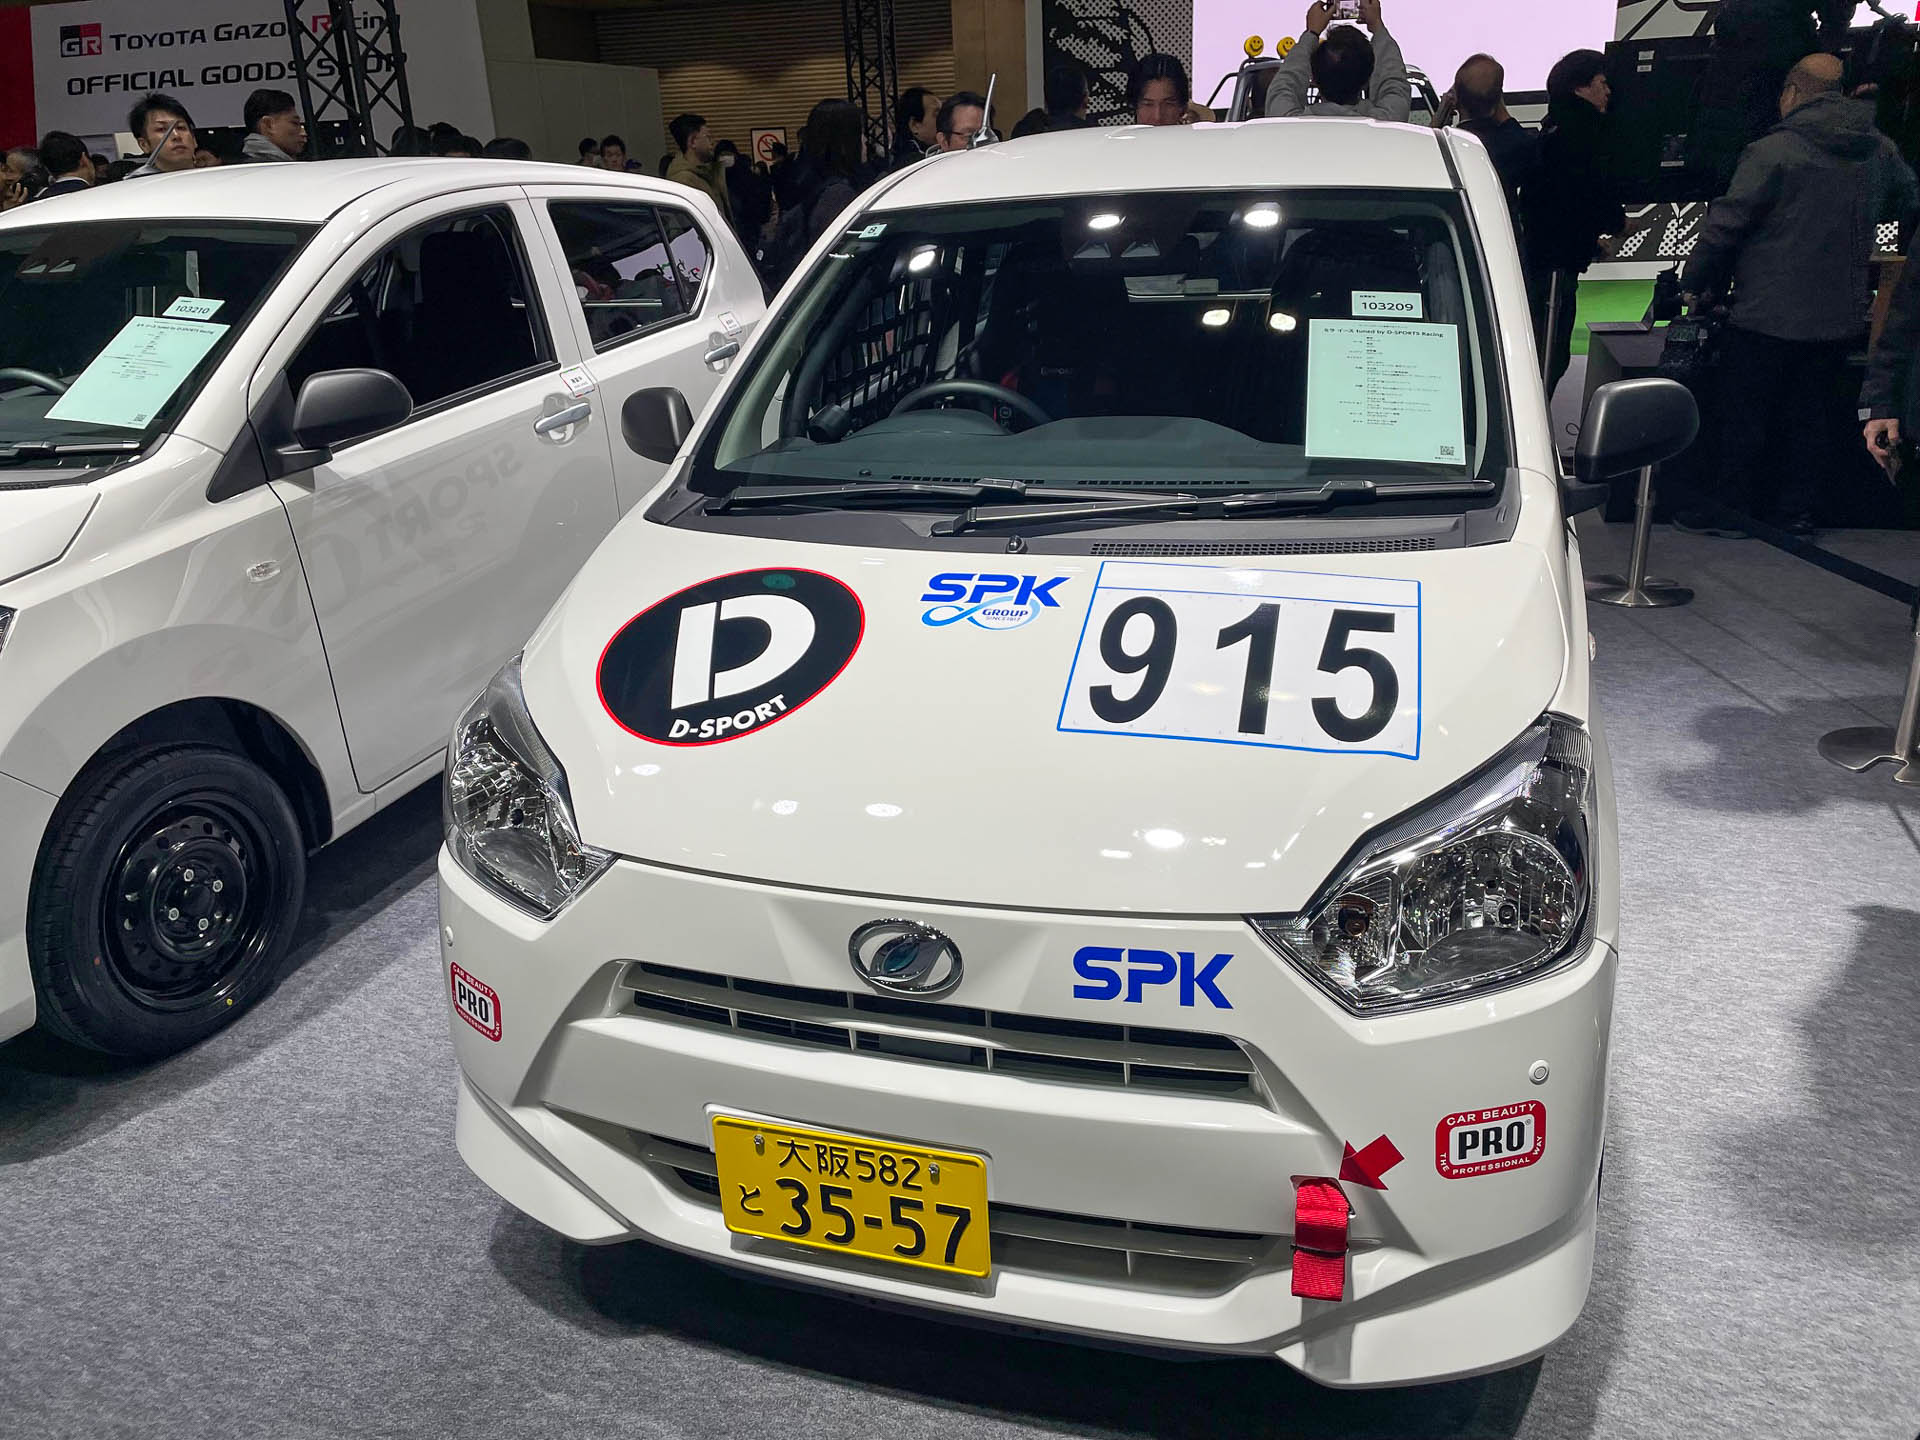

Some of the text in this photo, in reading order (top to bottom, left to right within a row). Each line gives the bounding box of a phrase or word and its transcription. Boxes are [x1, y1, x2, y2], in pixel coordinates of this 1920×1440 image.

[62, 36, 100, 56] GR
[110, 29, 207, 51] TOYOTA
[214, 21, 288, 42] GAZO
[67, 69, 195, 96] OFFICIAL
[175, 305, 210, 314] 103210
[1361, 302, 1414, 311] 103209
[920, 573, 1072, 607] SPK
[982, 608, 1028, 617] GROUP
[1089, 596, 1399, 742] 915
[668, 693, 788, 738] D-SPORT
[453, 964, 494, 997] CAR BEAUTY
[1073, 946, 1234, 1009] SPK
[458, 981, 489, 1023] PRO
[1446, 1103, 1536, 1126] CAR BEAUTY
[1440, 1136, 1543, 1175] THE PROFESSIONAL WAY
[1458, 1121, 1525, 1160] PRO
[738, 1177, 971, 1264] と 35-57
